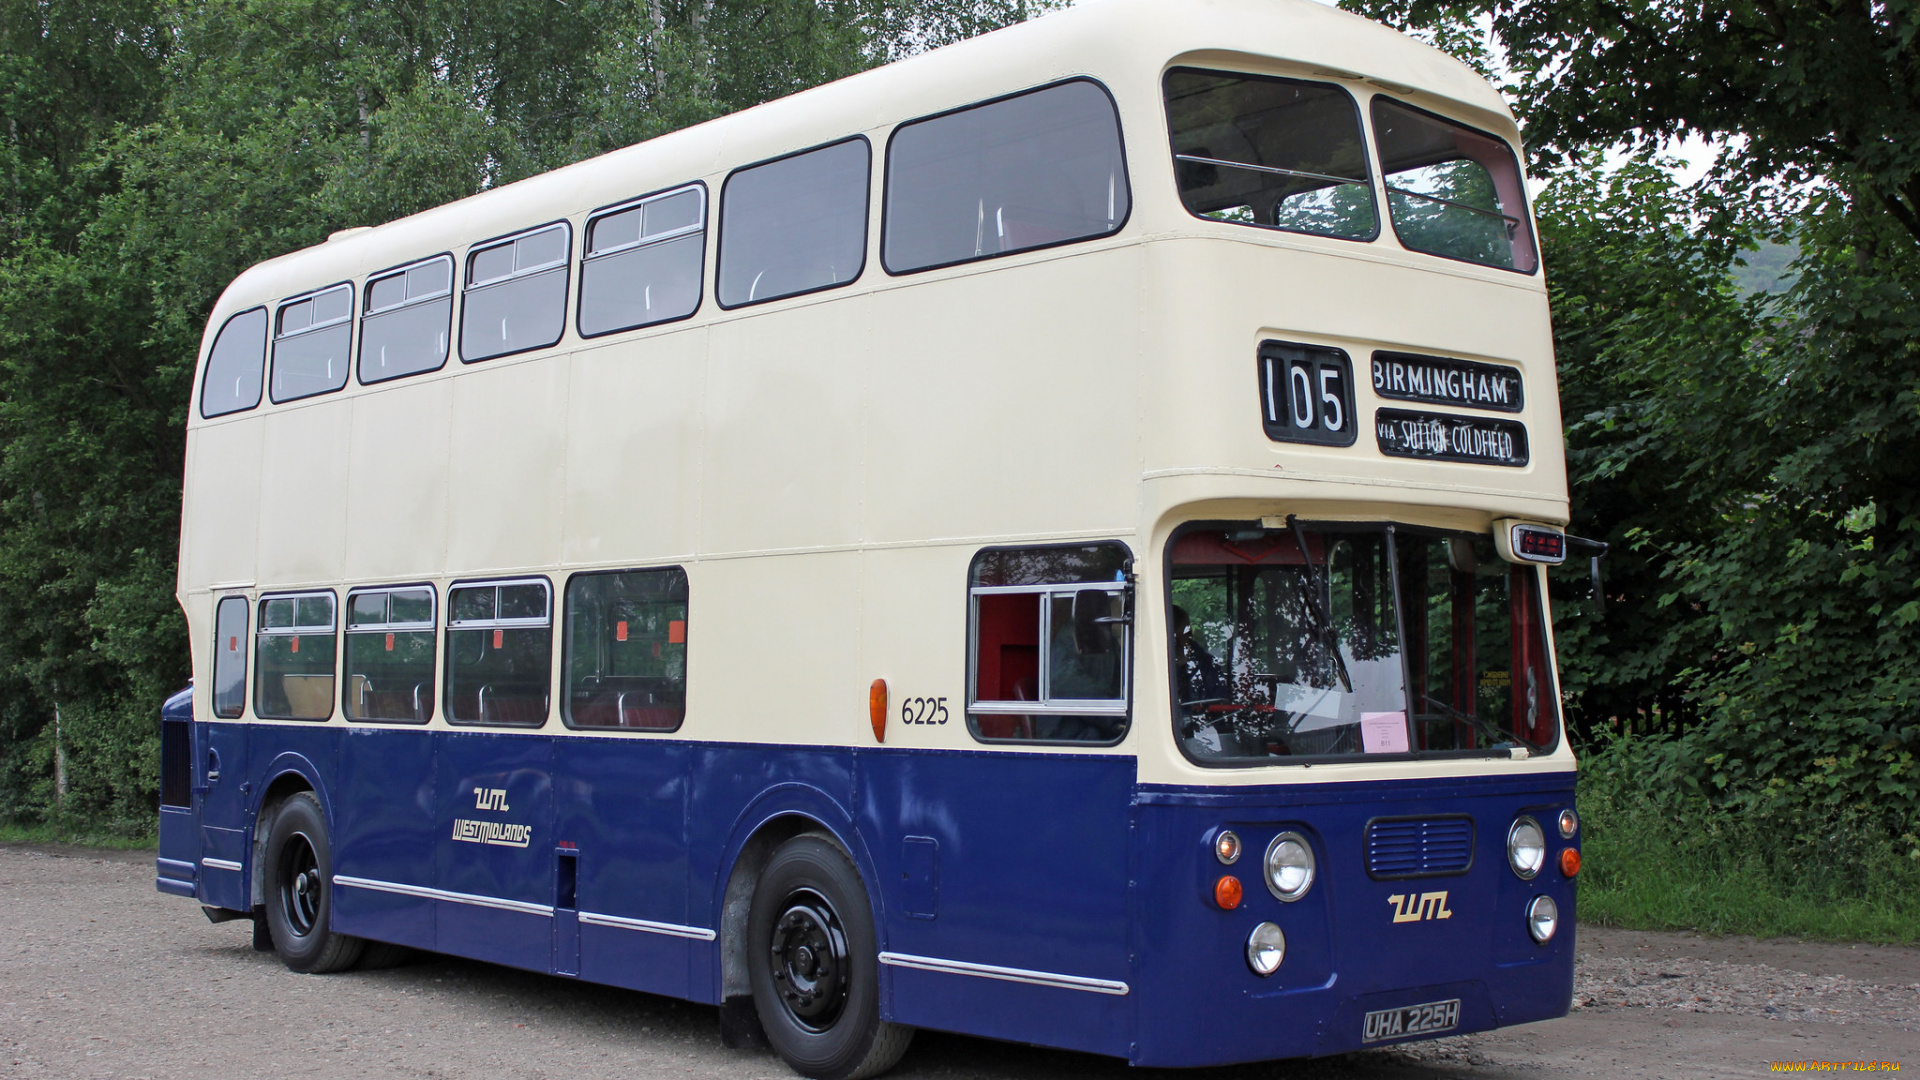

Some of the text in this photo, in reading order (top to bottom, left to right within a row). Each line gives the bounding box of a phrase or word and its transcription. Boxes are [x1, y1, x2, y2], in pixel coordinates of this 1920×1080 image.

[1266, 358, 1343, 432] 105
[1373, 360, 1508, 404] BIRMINGHAM
[1377, 420, 1512, 459] VIA SUTTON COLDFIELD
[902, 697, 949, 725] 6225
[1366, 1003, 1458, 1038] UHA 225H
